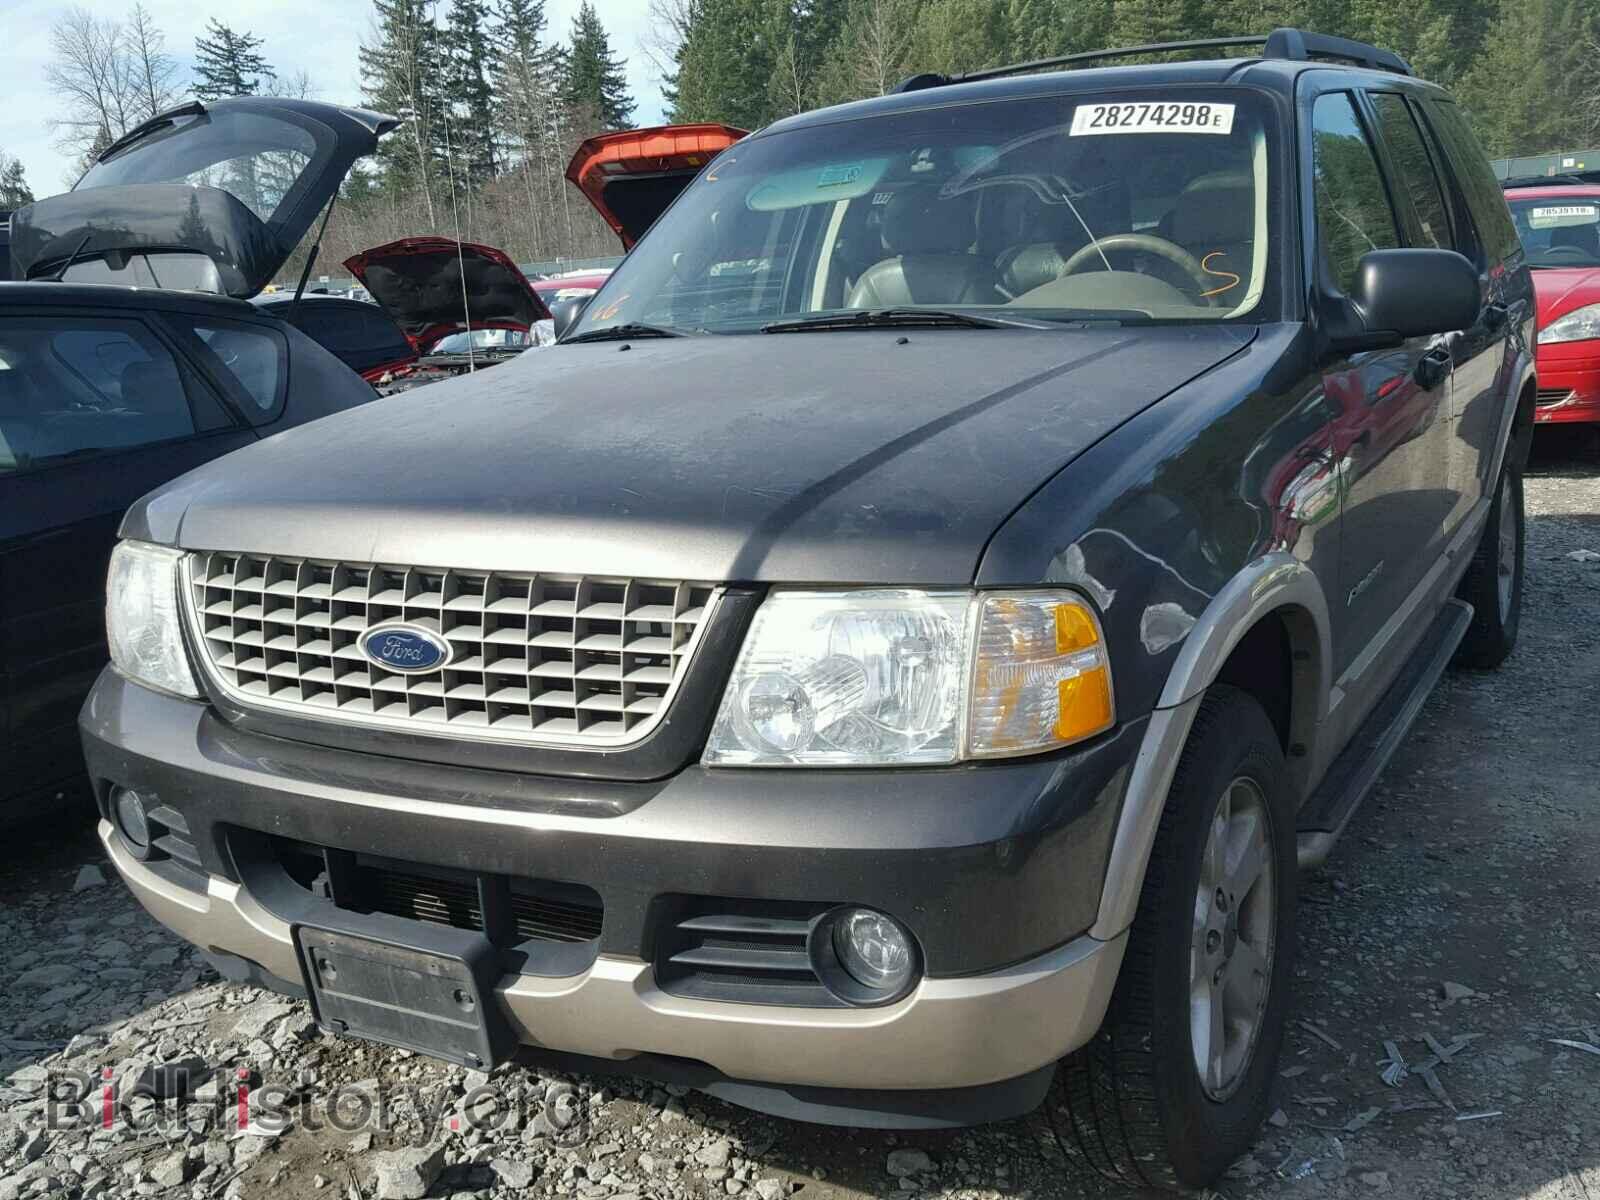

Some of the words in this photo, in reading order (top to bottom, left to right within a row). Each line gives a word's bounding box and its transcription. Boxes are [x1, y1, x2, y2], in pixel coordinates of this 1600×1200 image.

[1090, 104, 1212, 128] 28274298
[1212, 114, 1223, 128] E
[1199, 252, 1240, 297] S
[381, 635, 425, 661] Ford
